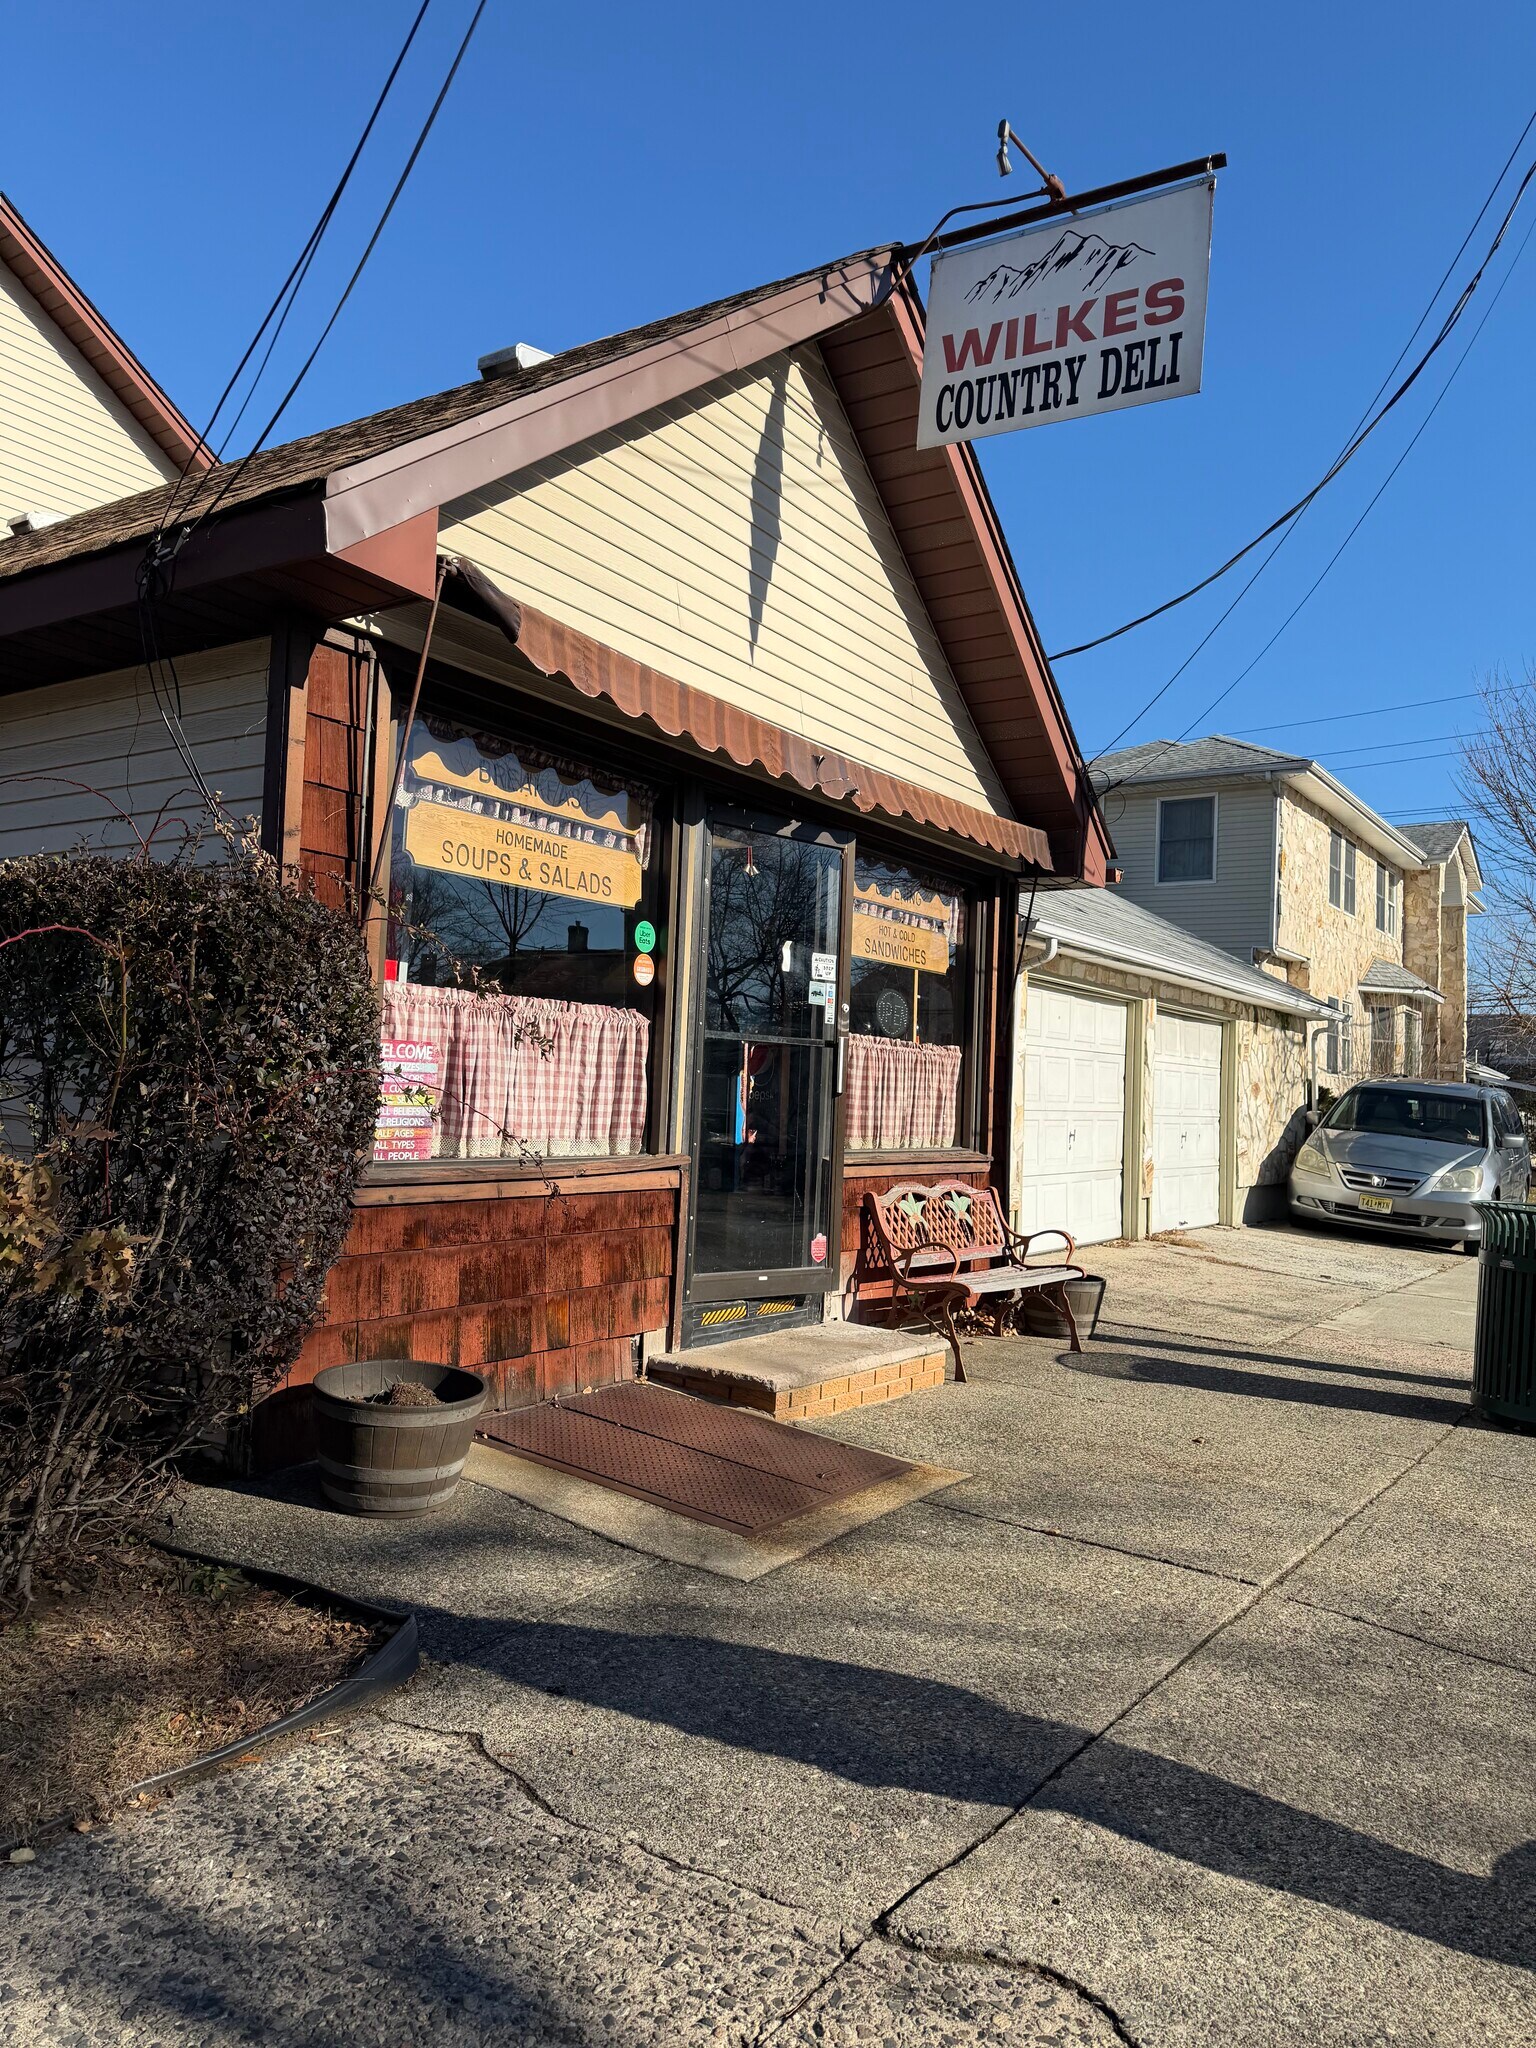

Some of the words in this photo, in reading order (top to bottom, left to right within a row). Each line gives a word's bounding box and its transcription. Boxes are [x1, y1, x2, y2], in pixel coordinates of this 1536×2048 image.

[941, 277, 1186, 374] WILKES
[935, 354, 1087, 433] COUNTRY
[1097, 331, 1183, 400] DELI
[496, 829, 569, 860] HOMEMADE
[441, 840, 512, 877] SOUPS
[518, 857, 532, 881] &
[539, 862, 612, 897] SALADS
[638, 936, 651, 945] Eats
[639, 929, 651, 938] Uber
[878, 925, 892, 937] HOT
[893, 929, 898, 939] &
[899, 929, 916, 943] COLD
[864, 937, 927, 965] SANDWICHES
[380, 1042, 434, 1060] ELCOME
[393, 1106, 421, 1115] BELIEFS
[387, 1117, 425, 1127] RELIGIONS
[377, 1129, 392, 1138] ALL
[394, 1129, 415, 1138] AGES
[374, 1140, 388, 1149] ALL
[392, 1140, 415, 1149] TYPES
[388, 1151, 420, 1160] PEOPLE
